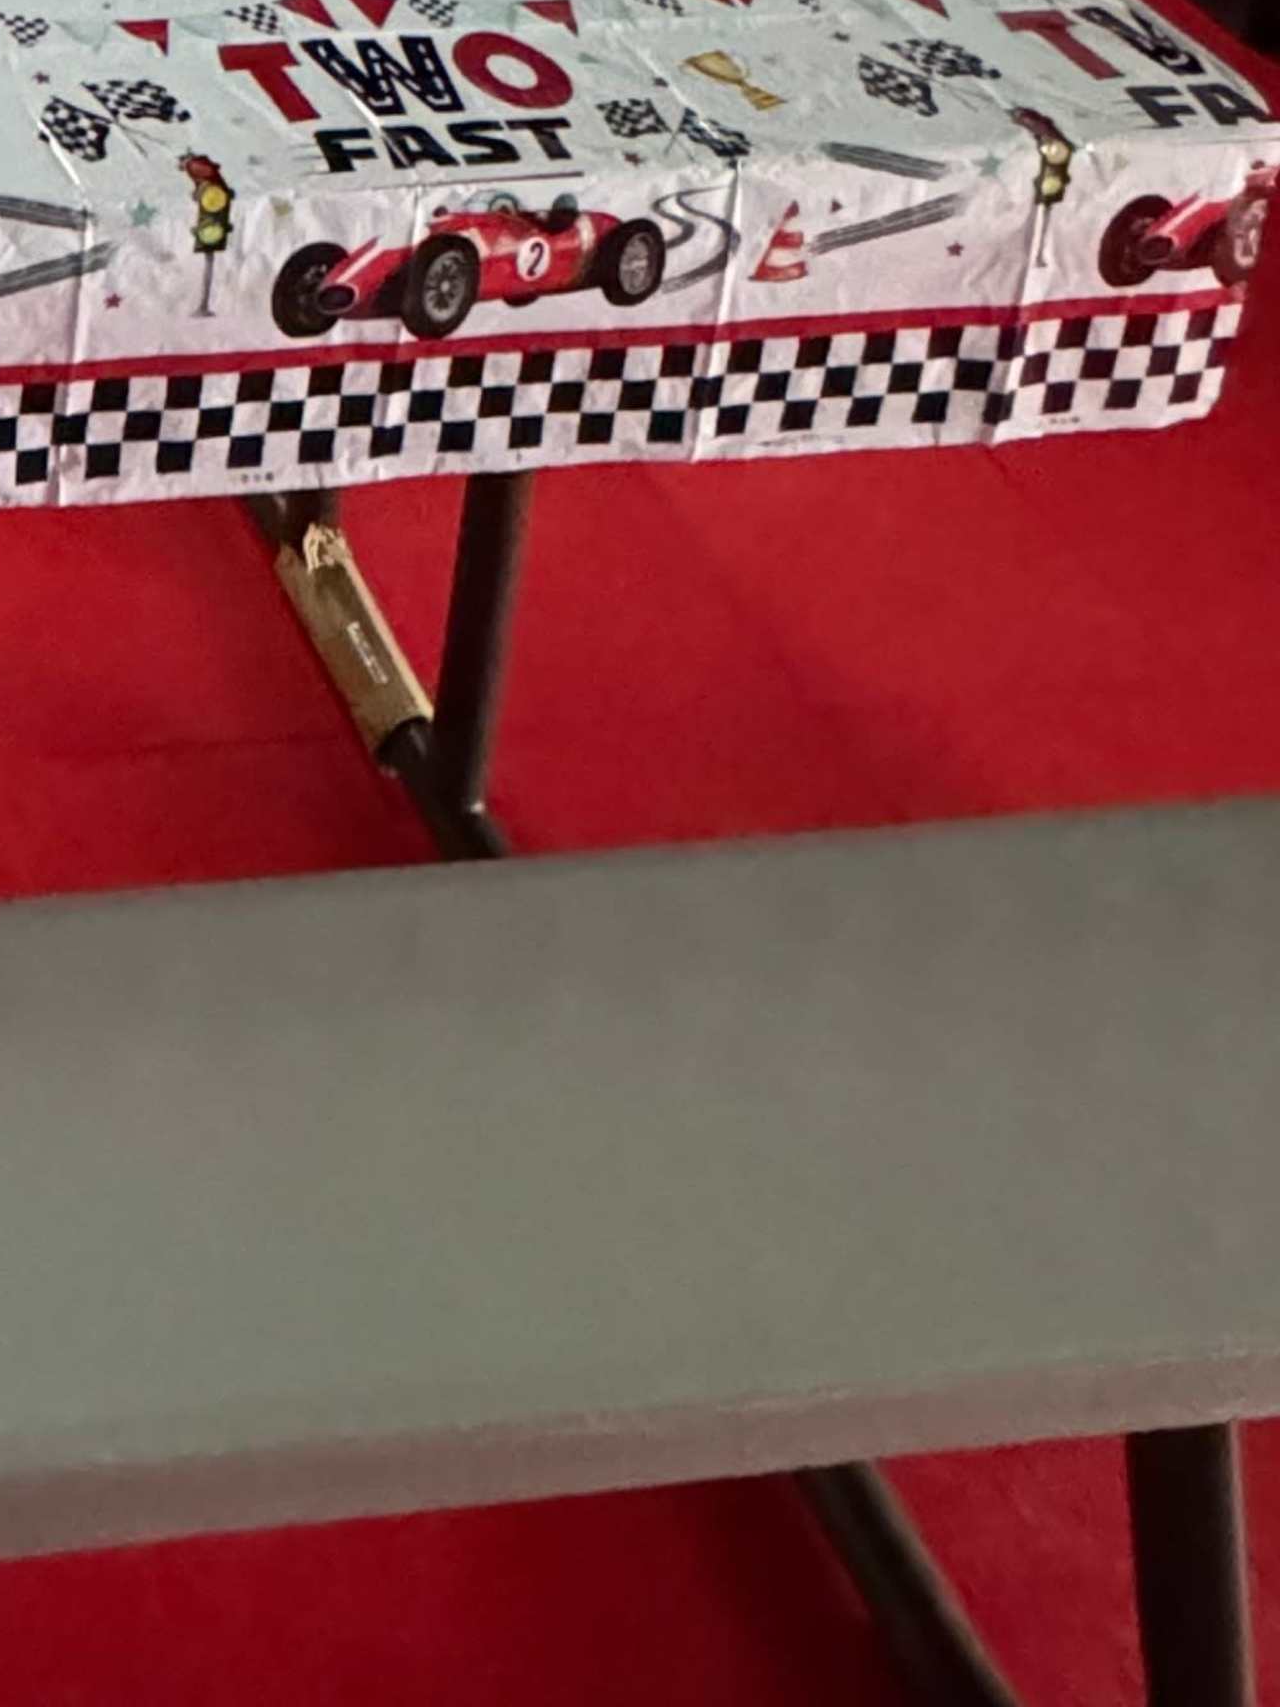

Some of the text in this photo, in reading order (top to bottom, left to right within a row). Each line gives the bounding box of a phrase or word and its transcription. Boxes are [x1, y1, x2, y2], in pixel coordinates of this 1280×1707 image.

[218, 32, 573, 123] TWO
[314, 118, 572, 174] FAST
[527, 242, 543, 274] 2
